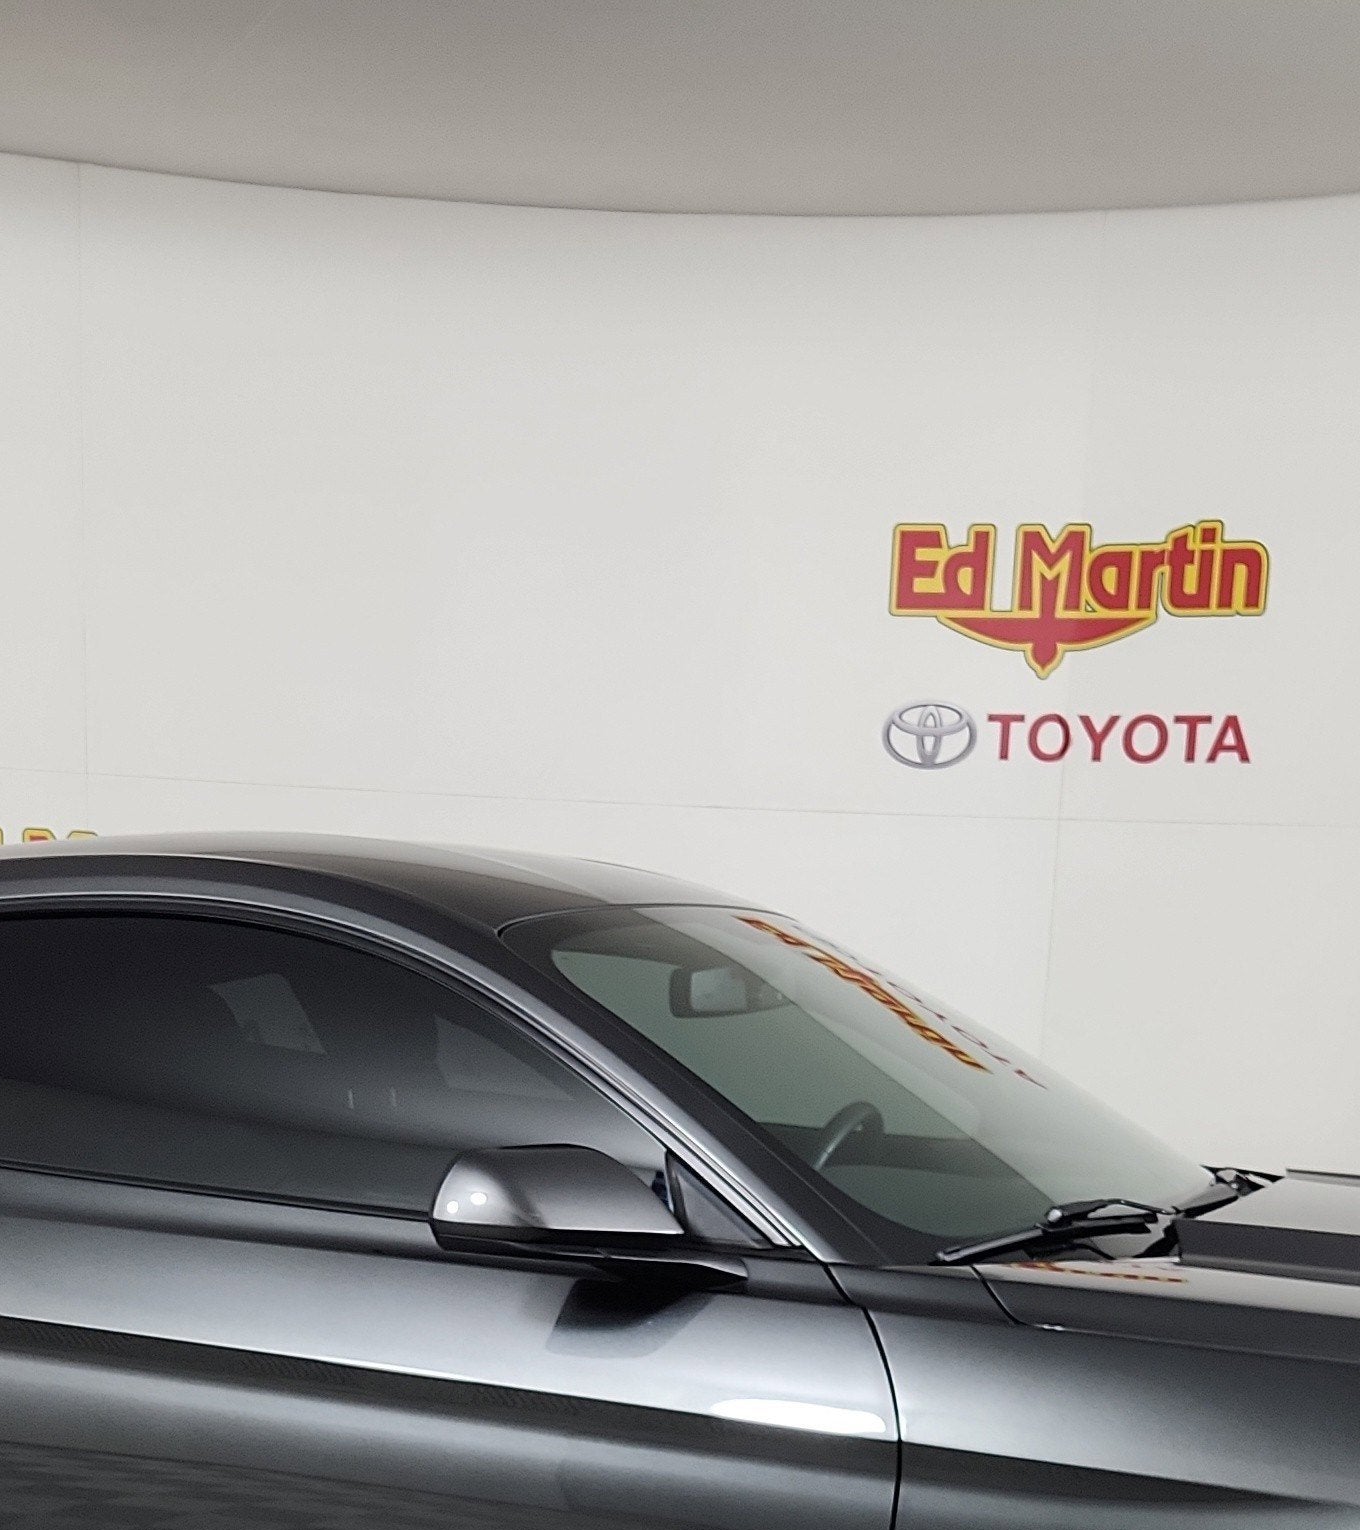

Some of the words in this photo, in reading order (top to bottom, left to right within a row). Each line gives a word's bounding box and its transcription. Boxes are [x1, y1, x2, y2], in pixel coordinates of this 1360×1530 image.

[890, 523, 996, 616] Ed
[1016, 520, 1270, 617] Martin
[987, 713, 1251, 764] TOYOTA
